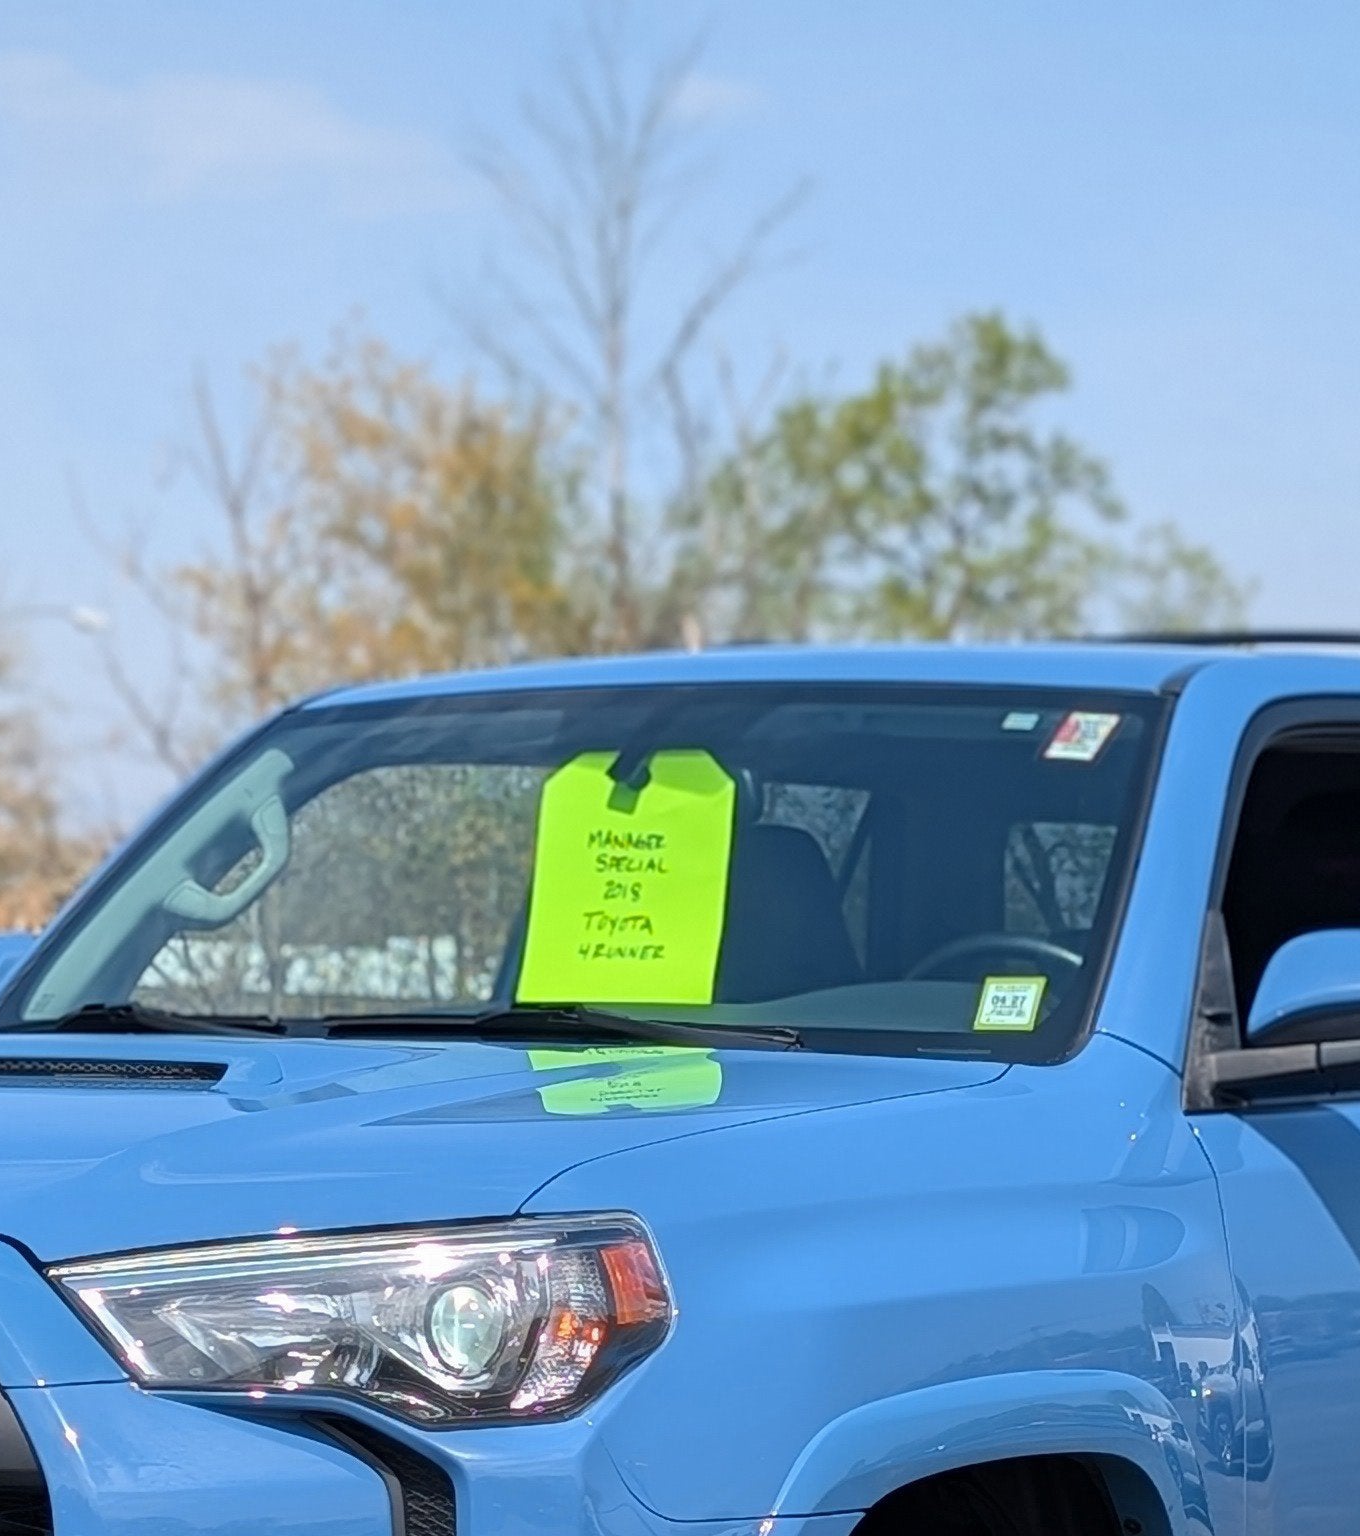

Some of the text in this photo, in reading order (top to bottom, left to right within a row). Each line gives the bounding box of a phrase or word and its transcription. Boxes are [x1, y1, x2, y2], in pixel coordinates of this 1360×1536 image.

[587, 830, 666, 850] MANAGER
[595, 855, 668, 874] SPECIAL
[603, 879, 643, 902] 2018
[583, 911, 653, 936] TOYOTA
[578, 943, 666, 960] 4RUNNER
